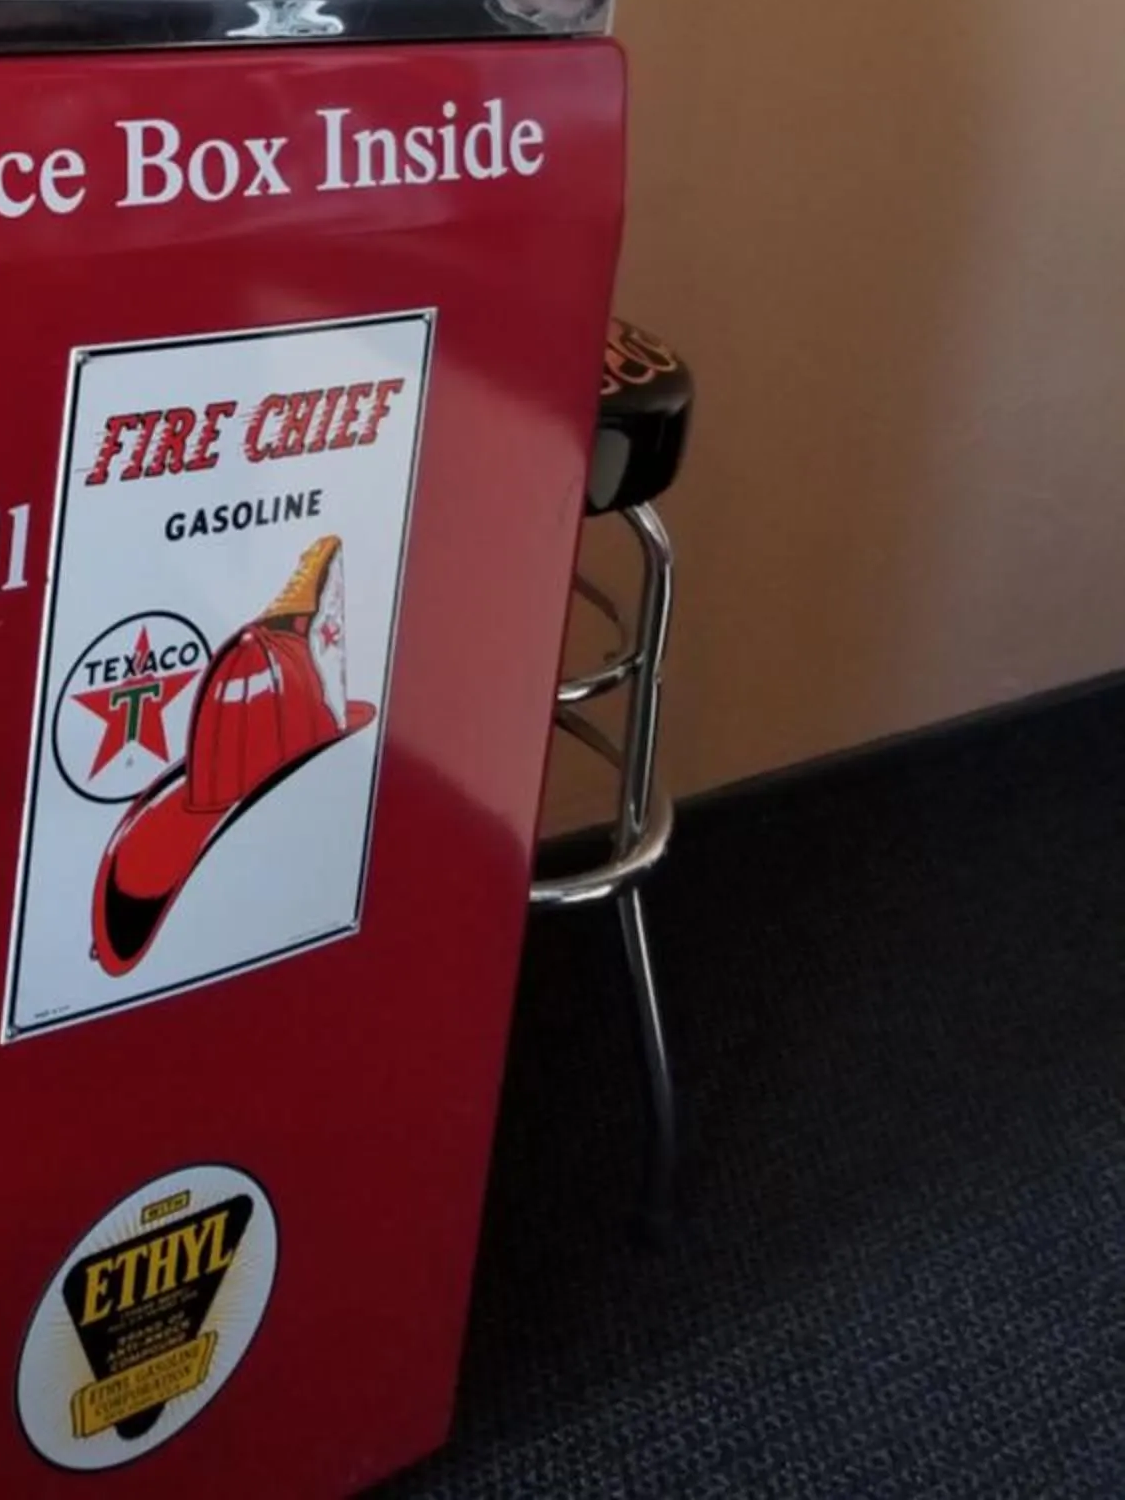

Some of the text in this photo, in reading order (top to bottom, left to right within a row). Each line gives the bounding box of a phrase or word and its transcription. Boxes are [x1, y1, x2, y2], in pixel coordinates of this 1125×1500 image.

[114, 117, 291, 209] Box
[315, 99, 546, 192] Inside
[83, 377, 406, 487] FIRE CHIEF
[164, 487, 324, 542] GASOLINE
[84, 640, 201, 686] TEXACO
[80, 1210, 234, 1328] ETHYL
